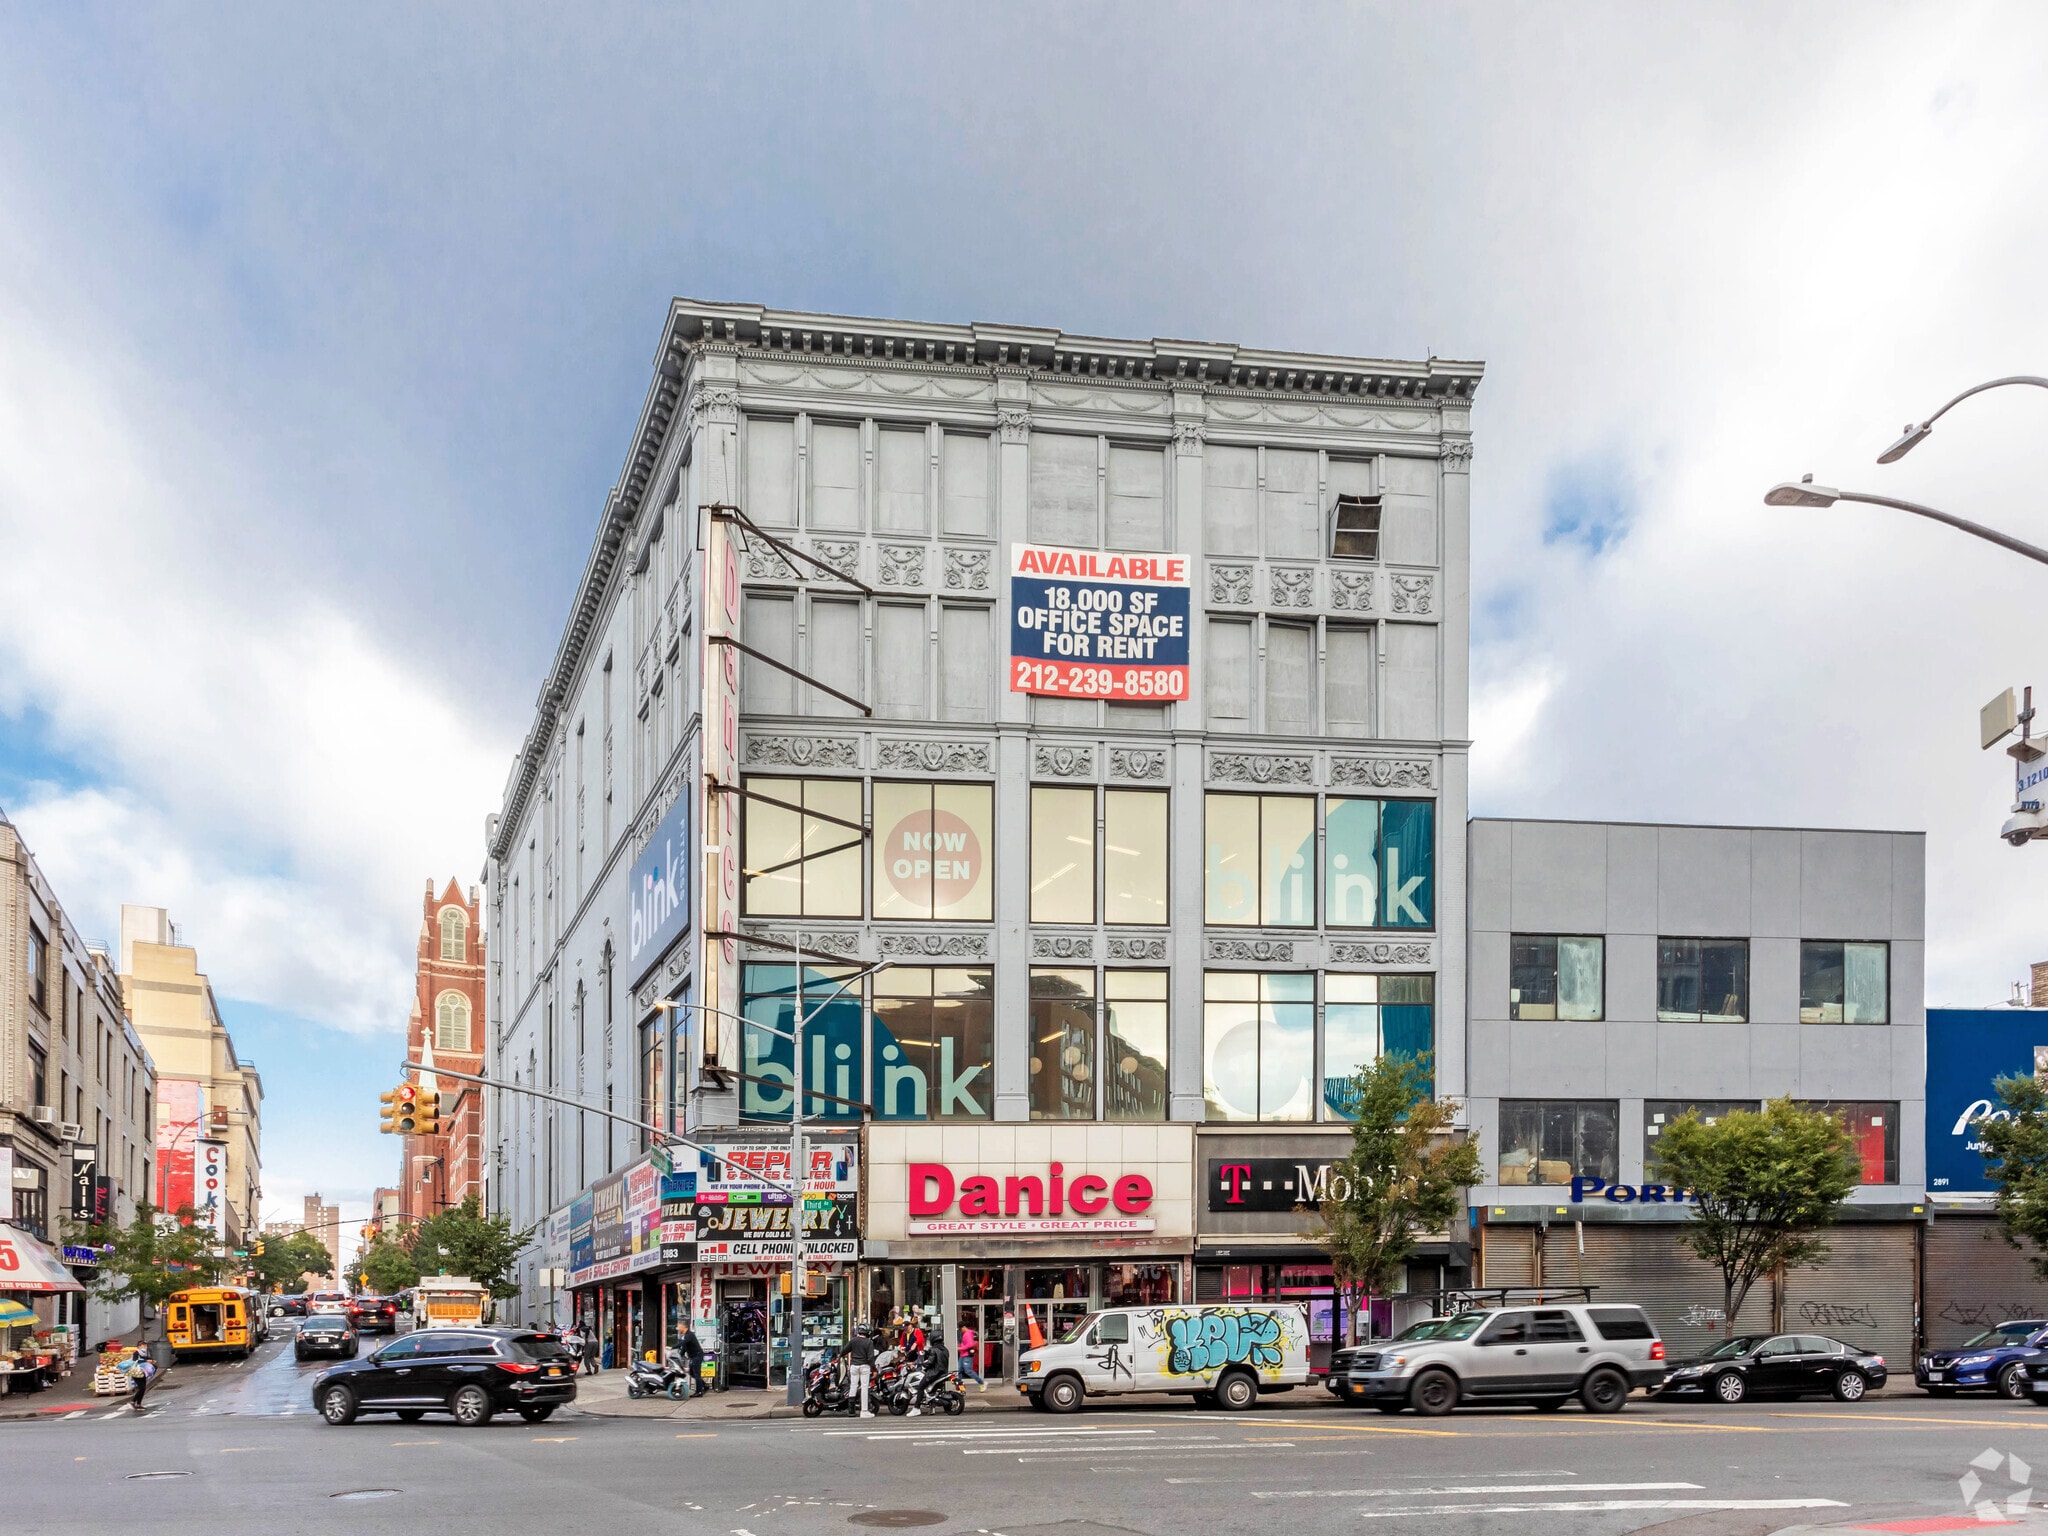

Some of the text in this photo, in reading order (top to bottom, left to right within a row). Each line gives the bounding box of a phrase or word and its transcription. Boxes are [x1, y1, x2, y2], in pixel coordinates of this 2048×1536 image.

[1018, 550, 1184, 581] AVAILABLE
[1044, 587, 1158, 614] 18,000 SF
[1017, 606, 1184, 637] OFFICE SPACE
[1043, 631, 1159, 659] FOR RENT
[1016, 661, 1184, 696] 212-239-8580
[903, 831, 967, 852] NOW
[893, 859, 970, 880] OPEN
[1209, 843, 1428, 923] blink
[631, 838, 680, 961] blink
[745, 1034, 987, 1115] blink
[725, 1151, 834, 1171] REPR
[74, 1161, 96, 1219] Nails
[814, 1181, 836, 1189] HOUR
[908, 1161, 1154, 1216] Danice
[1933, 1178, 1949, 1186] 2891
[806, 1201, 822, 1210] Third
[926, 1219, 1138, 1231] GREAT STYLE GREAT PRICE
[733, 1243, 759, 1254] CELL
